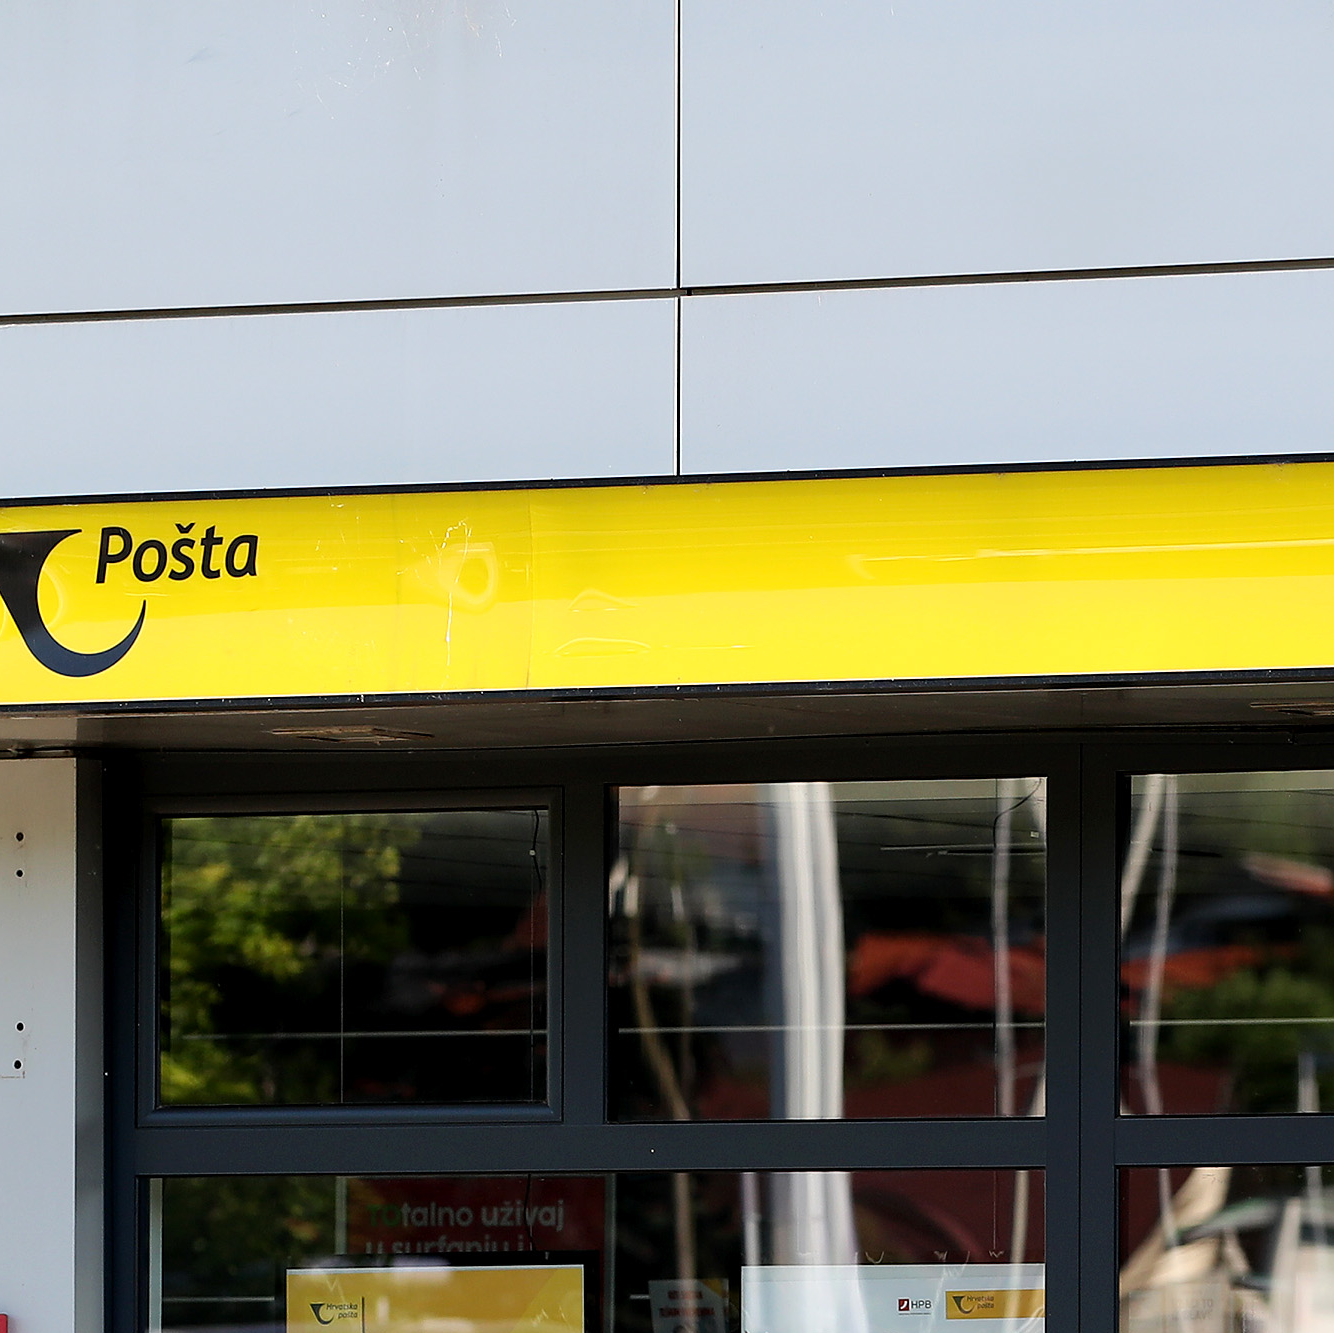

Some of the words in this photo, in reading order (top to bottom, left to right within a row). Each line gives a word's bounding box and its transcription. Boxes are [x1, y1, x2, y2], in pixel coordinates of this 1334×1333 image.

[95, 522, 259, 584] Pošta
[367, 1201, 474, 1227] TOtalno
[481, 1199, 565, 1232] uživaj
[338, 1311, 357, 1319] pošta
[911, 1301, 932, 1309] HPB
